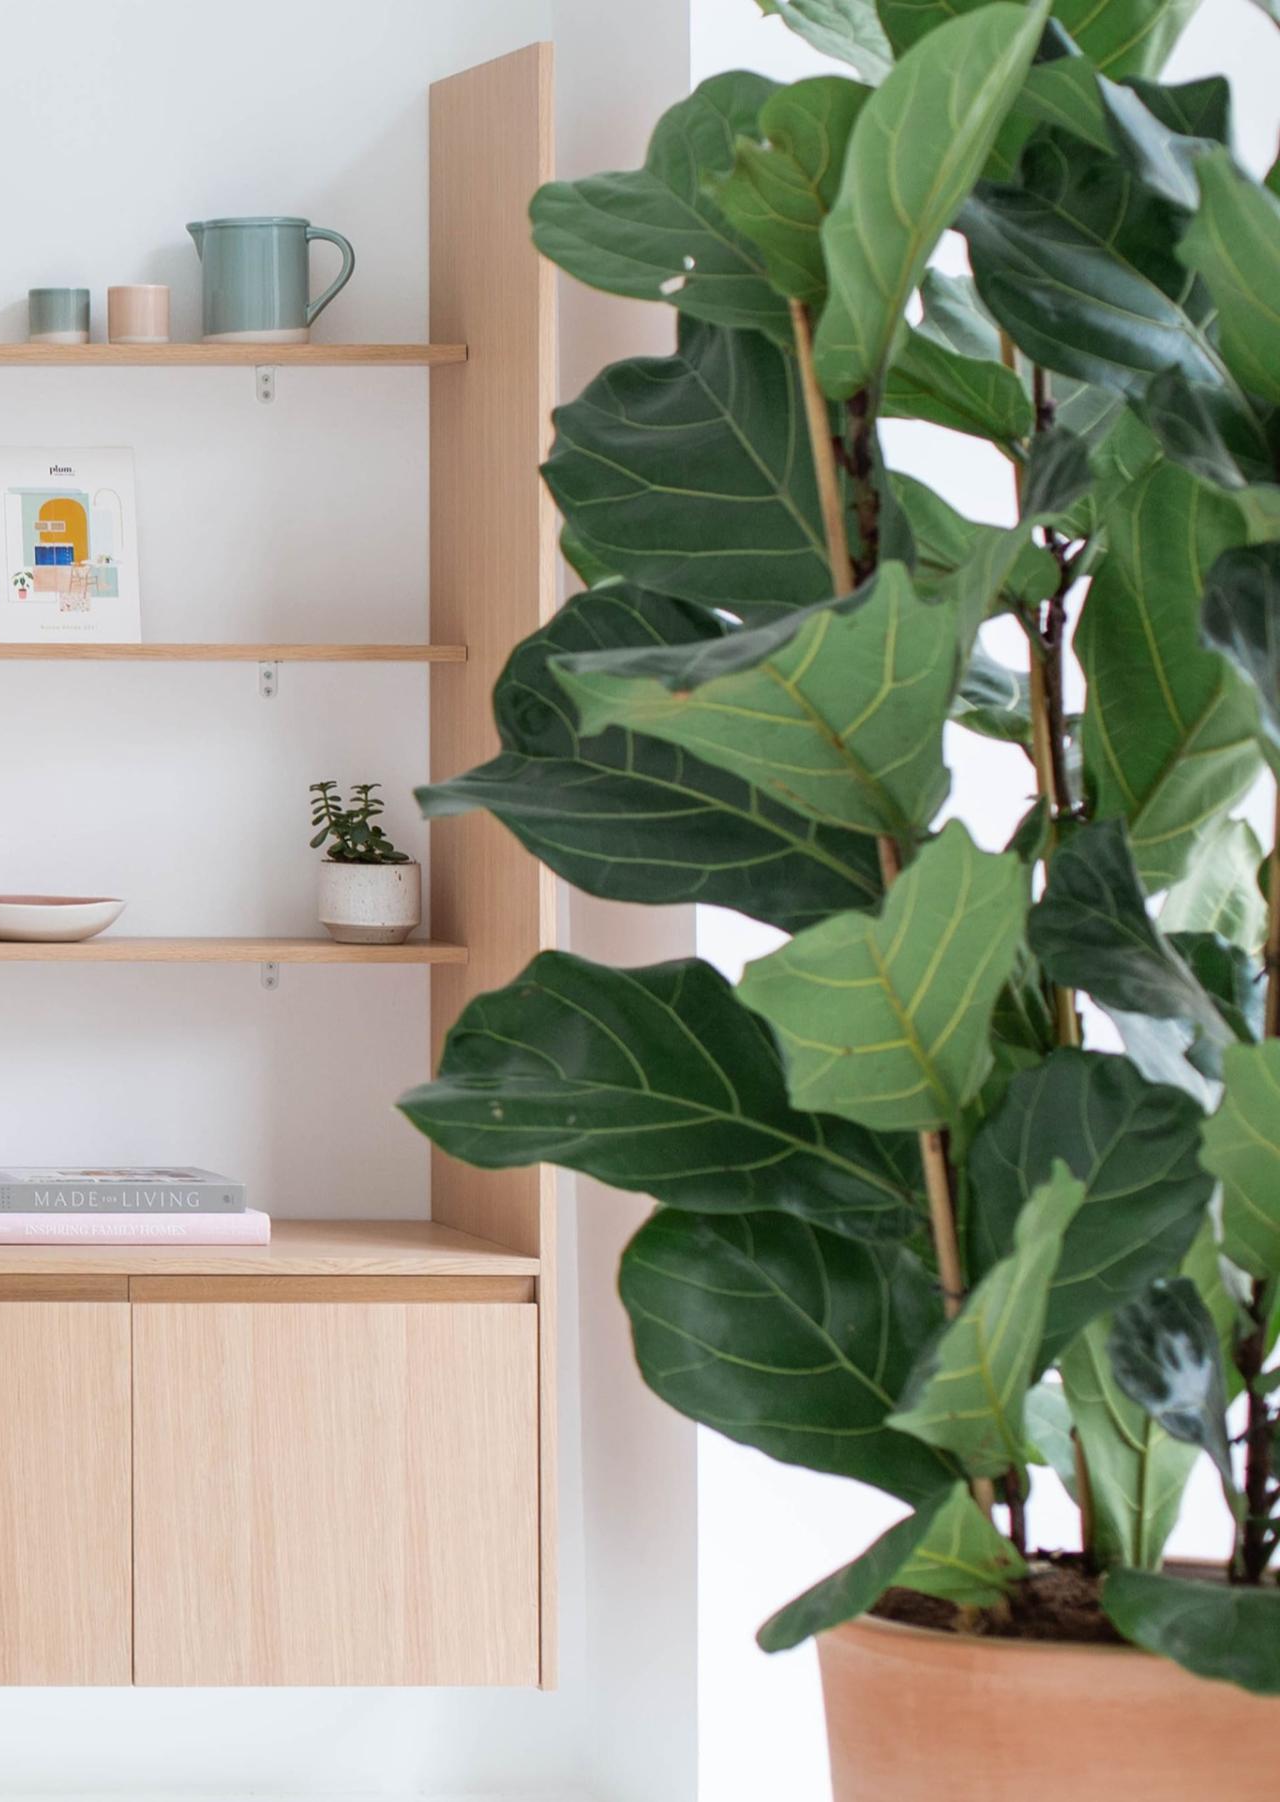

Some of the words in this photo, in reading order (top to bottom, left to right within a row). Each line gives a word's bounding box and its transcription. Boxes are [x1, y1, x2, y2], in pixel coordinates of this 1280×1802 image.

[34, 1190, 99, 1208] MADE
[122, 1190, 201, 1208] LIVING
[25, 1223, 90, 1237] INSPIRING
